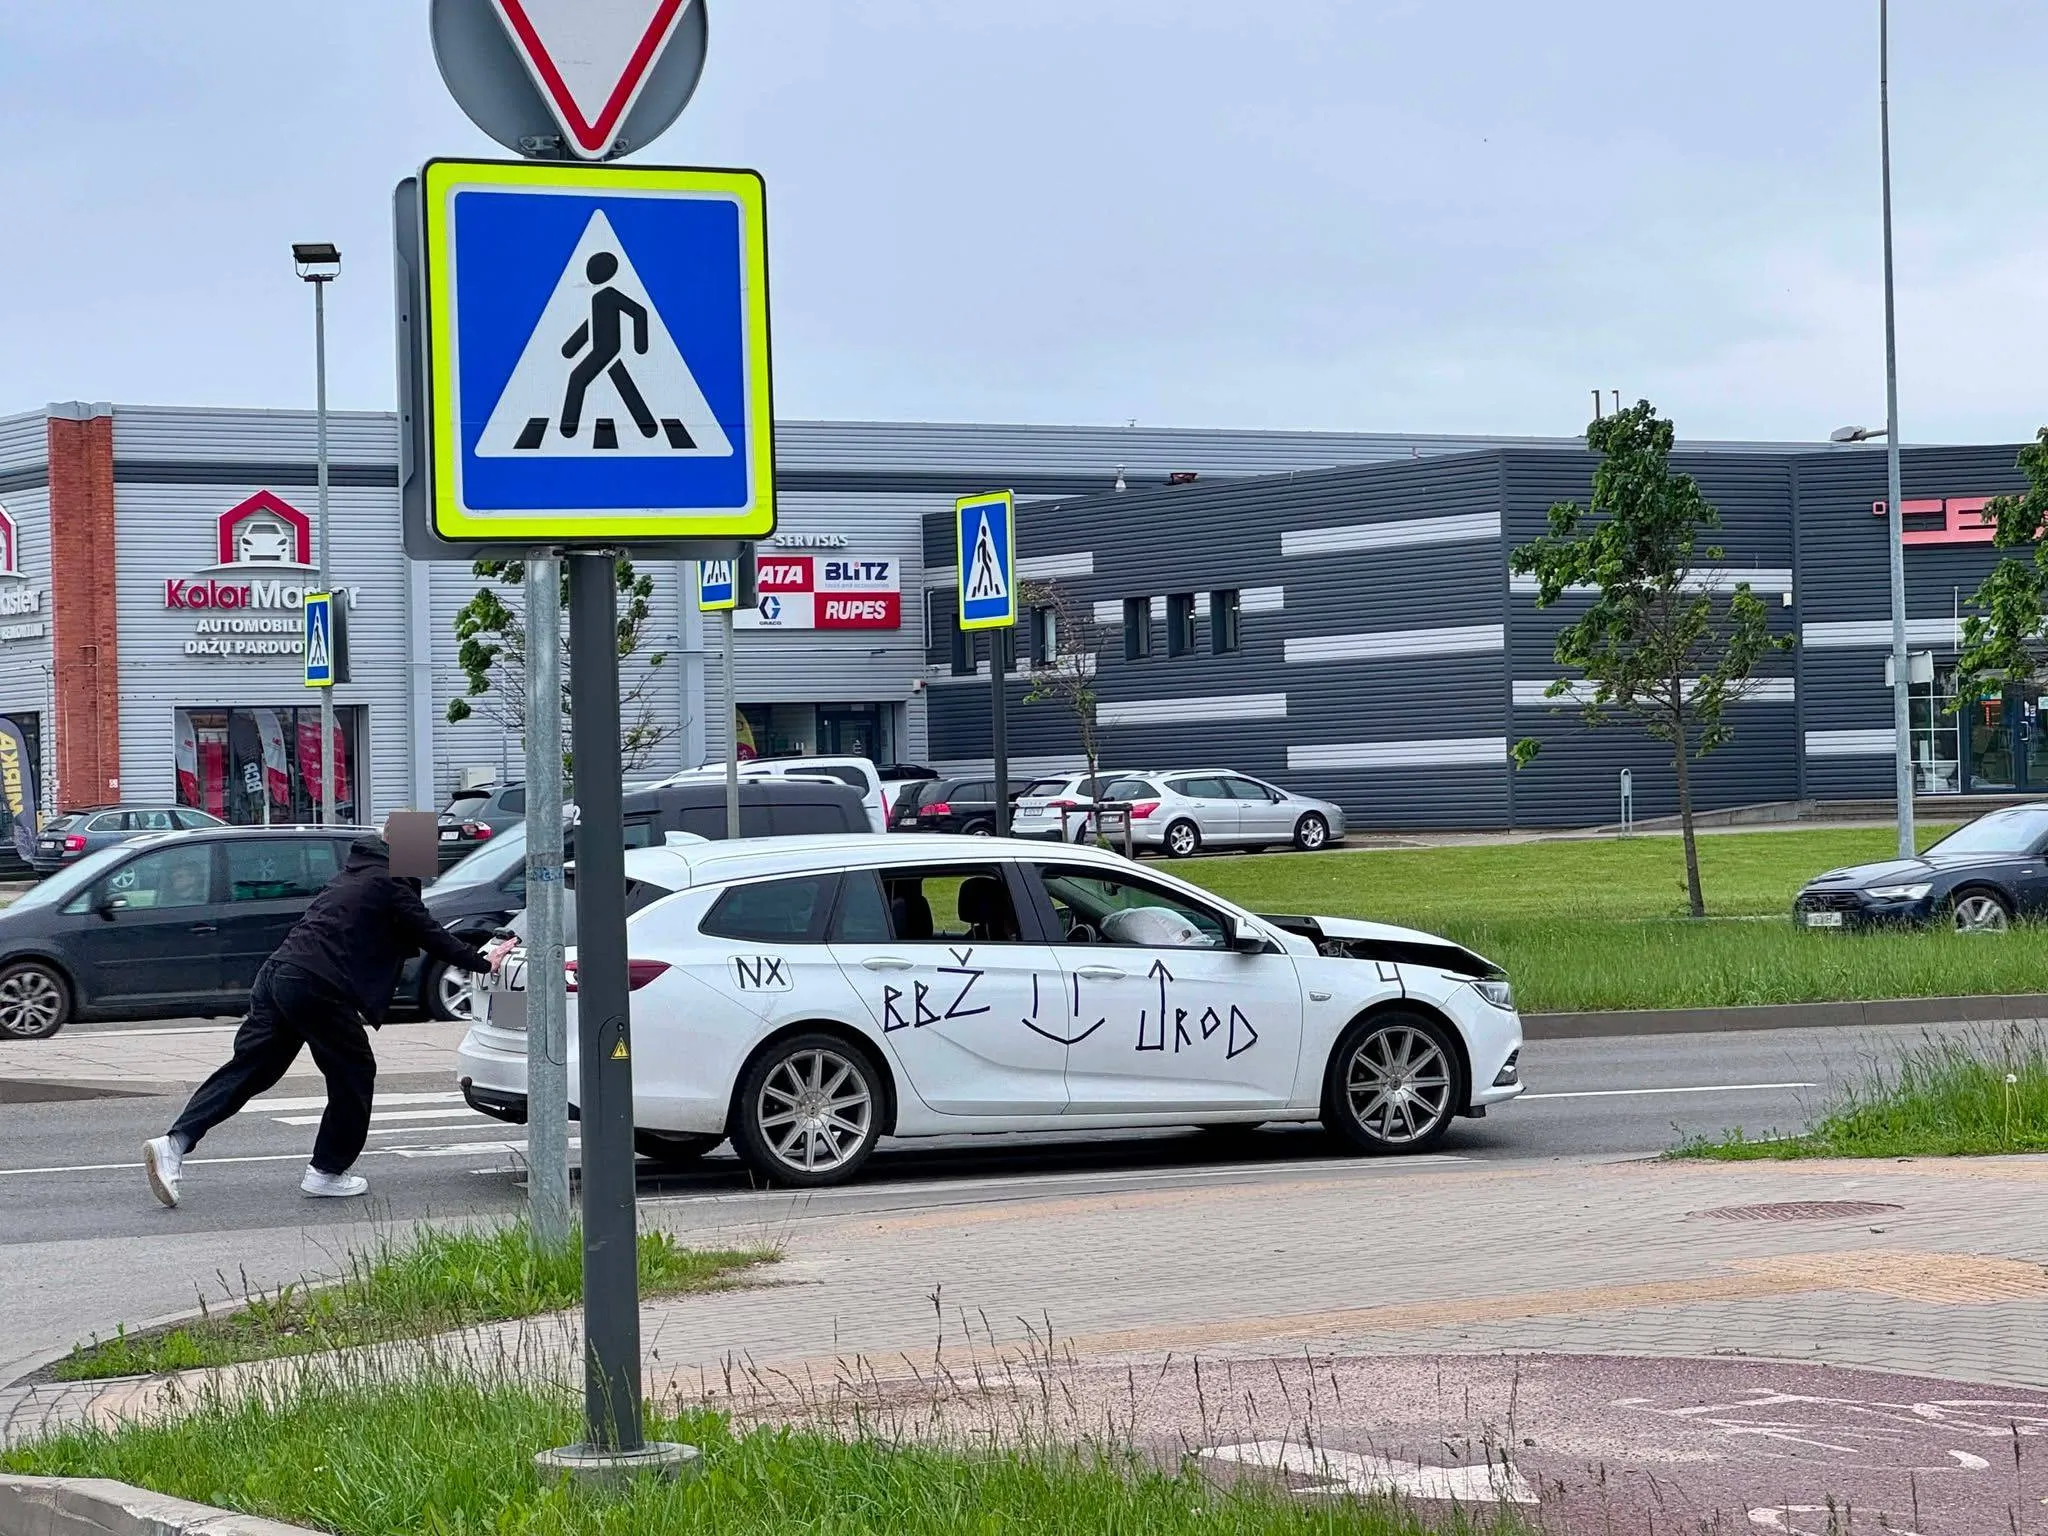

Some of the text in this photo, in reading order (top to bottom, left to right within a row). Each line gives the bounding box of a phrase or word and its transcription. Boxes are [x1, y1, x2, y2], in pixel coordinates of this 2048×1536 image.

[776, 534, 848, 548] SERVISAS
[825, 600, 887, 620] RUPES
[185, 637, 305, 658] DAŽŲ PARDUO
[735, 956, 787, 989] NX
[1135, 962, 1259, 1060] UROD
